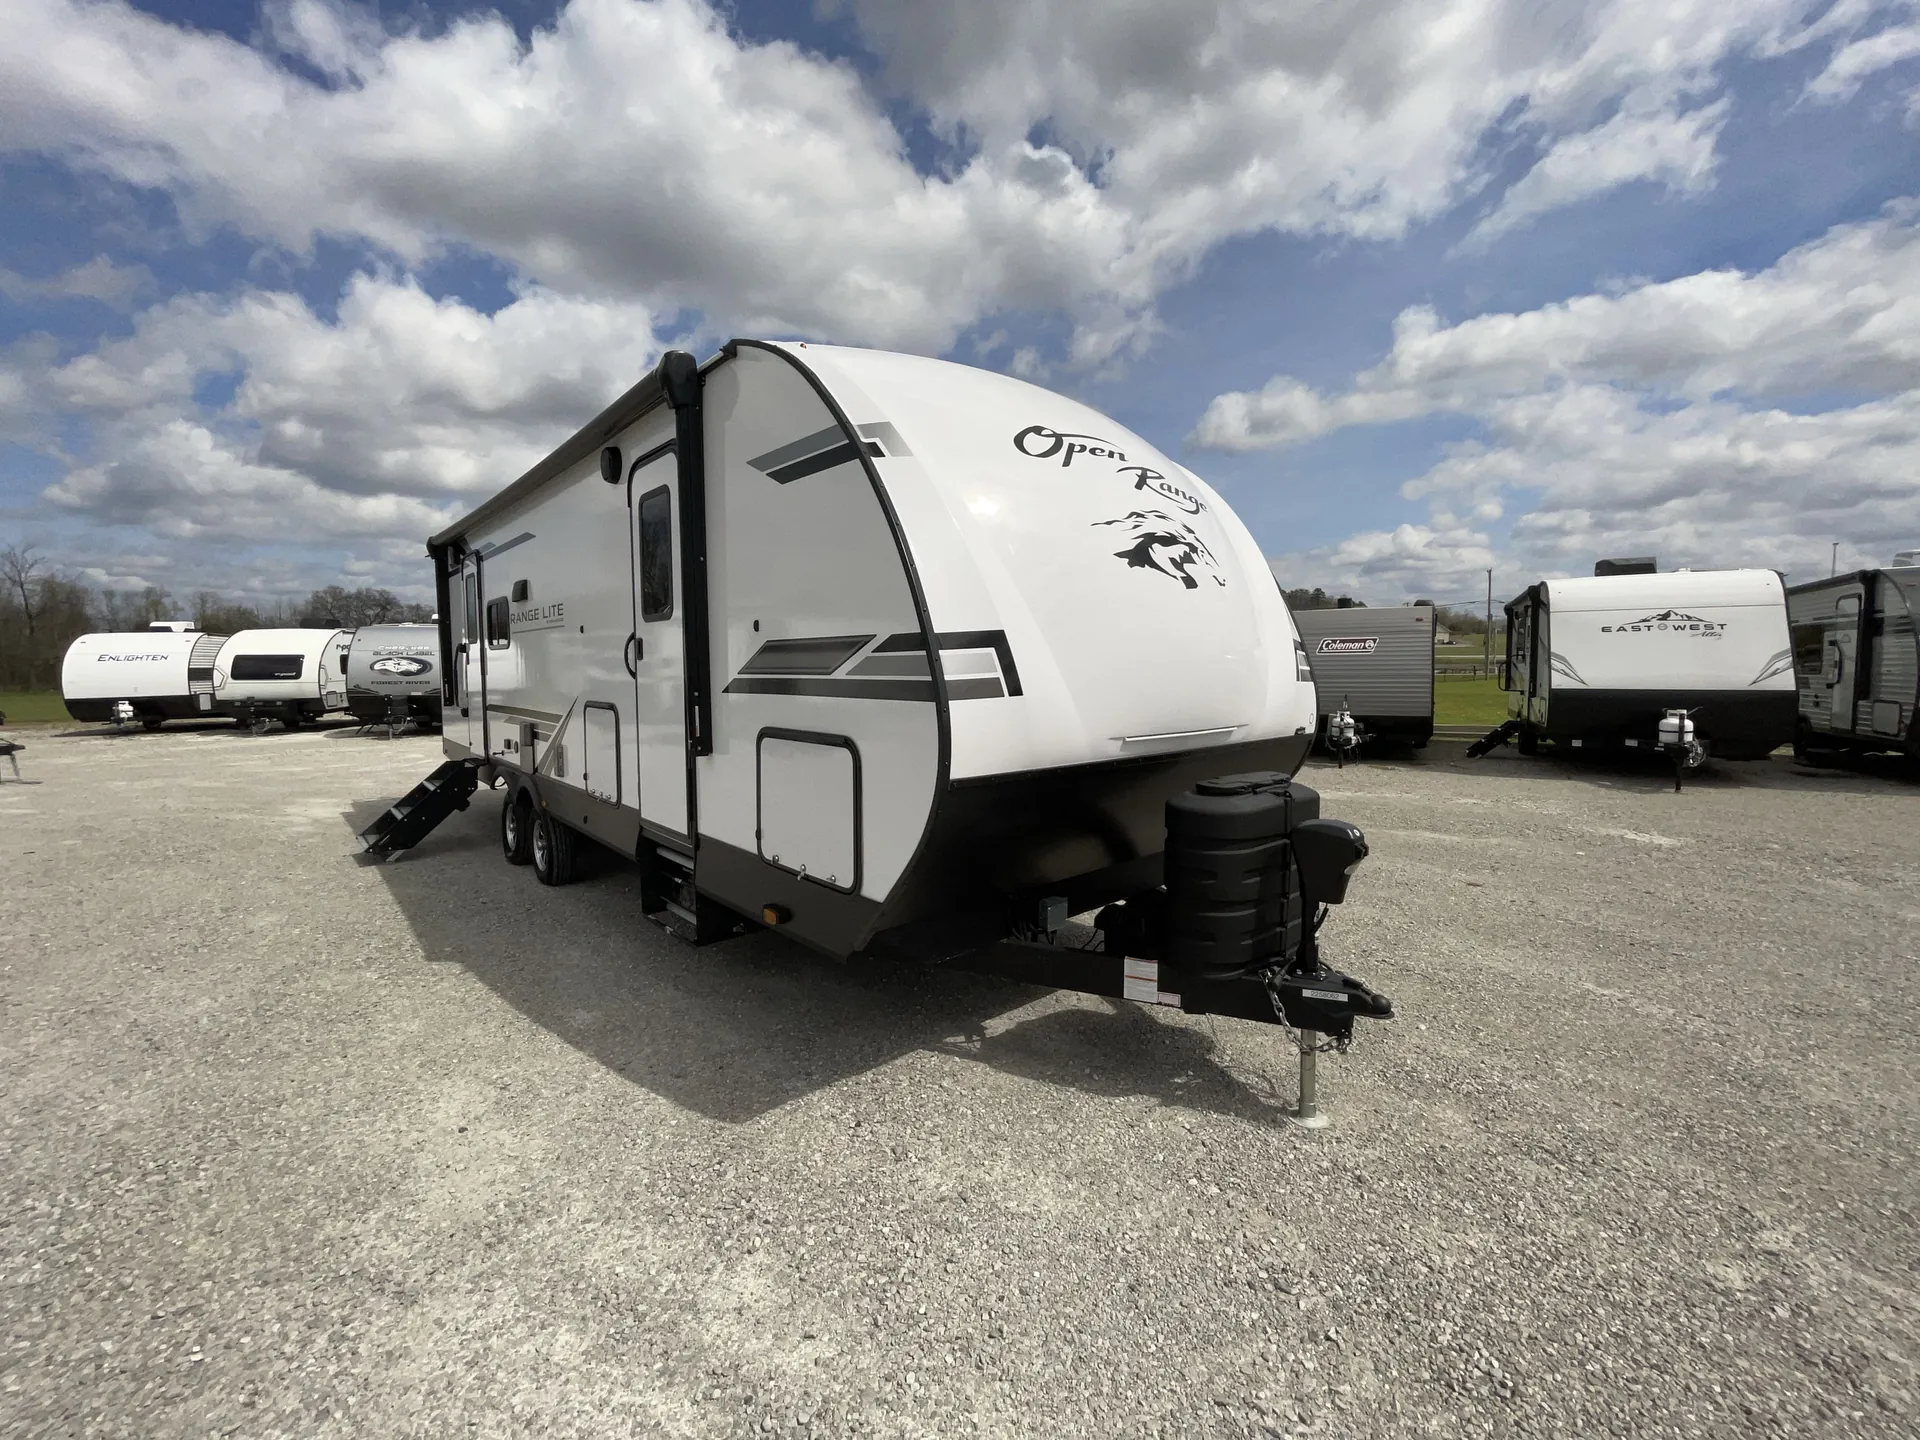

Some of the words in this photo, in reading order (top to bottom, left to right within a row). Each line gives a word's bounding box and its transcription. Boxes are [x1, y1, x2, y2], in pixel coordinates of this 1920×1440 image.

[1013, 425, 1128, 467] Open
[1116, 466, 1208, 515] Range
[510, 608, 539, 625] RANGE
[542, 603, 564, 618] LITE
[1601, 624, 1654, 633] EAST
[1672, 623, 1728, 631] WEST
[1322, 640, 1365, 651] Coleman
[97, 654, 169, 662] ENLIGHTEN
